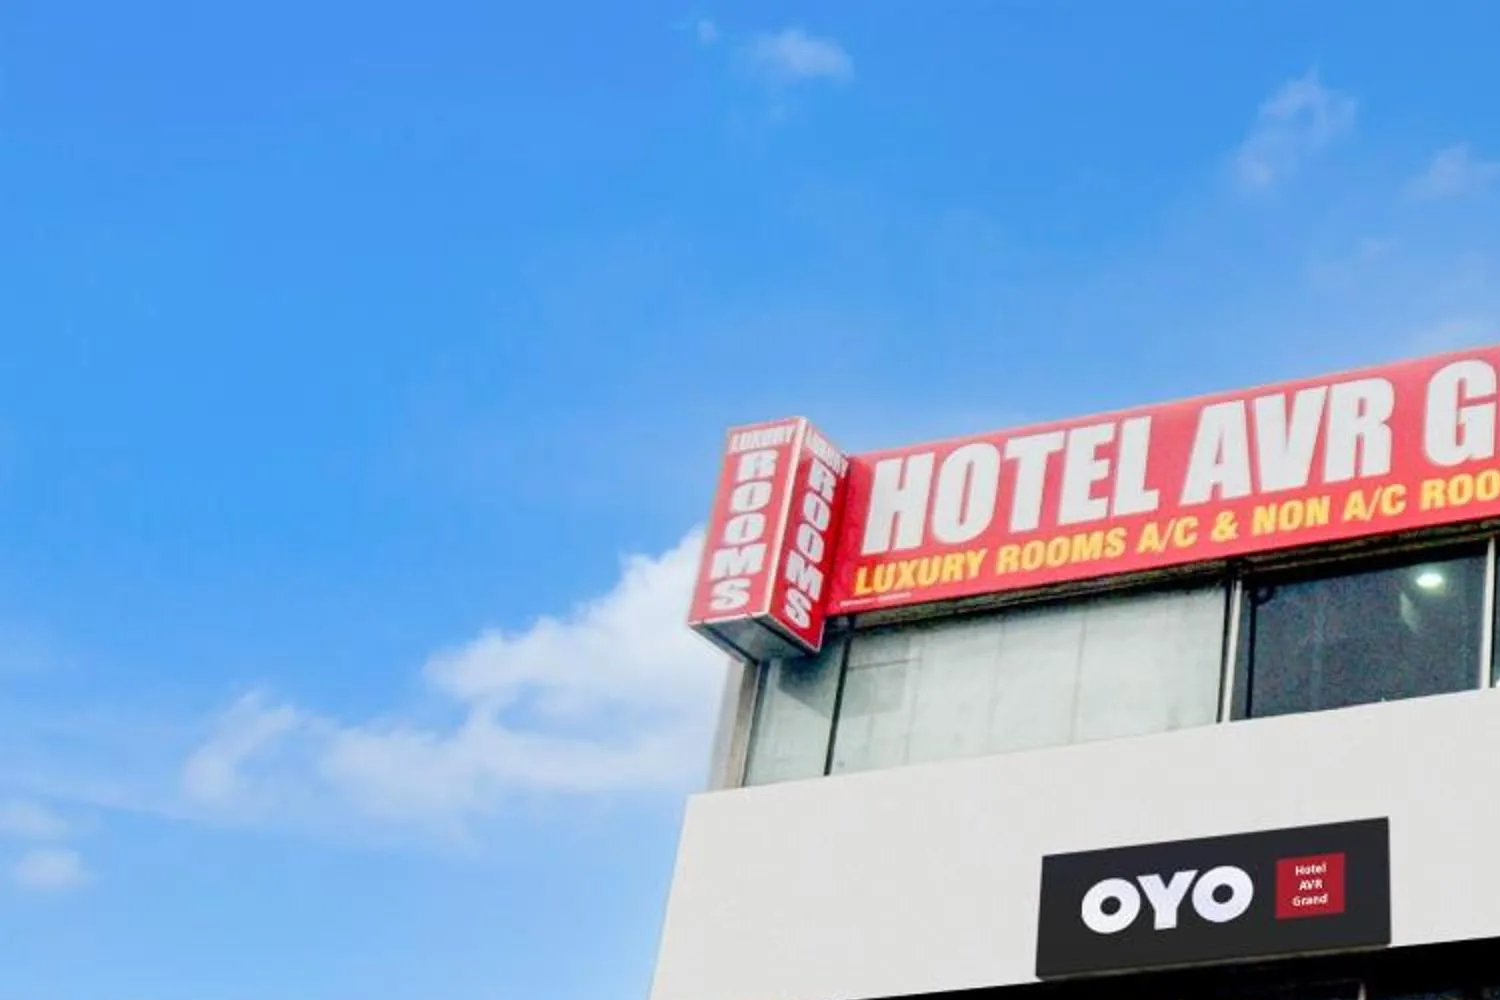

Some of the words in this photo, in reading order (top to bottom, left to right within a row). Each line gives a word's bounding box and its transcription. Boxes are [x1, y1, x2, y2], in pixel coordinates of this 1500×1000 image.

[731, 426, 797, 453] LUXURY
[860, 415, 1160, 556] HOTEL
[1179, 377, 1395, 506] AVR
[709, 450, 779, 612] ROOMS
[784, 457, 837, 629] ROOMS
[855, 548, 988, 595] LUXURY
[996, 527, 1127, 574] ROOMS
[1135, 515, 1200, 553] A/C
[1210, 510, 1239, 542] &
[1252, 495, 1331, 537] NON
[1343, 484, 1407, 522] A/C
[1081, 865, 1254, 934] OYO
[1292, 893, 1328, 907] Grand
[1295, 862, 1328, 876] Hotel
[1299, 878, 1323, 891] AVR
